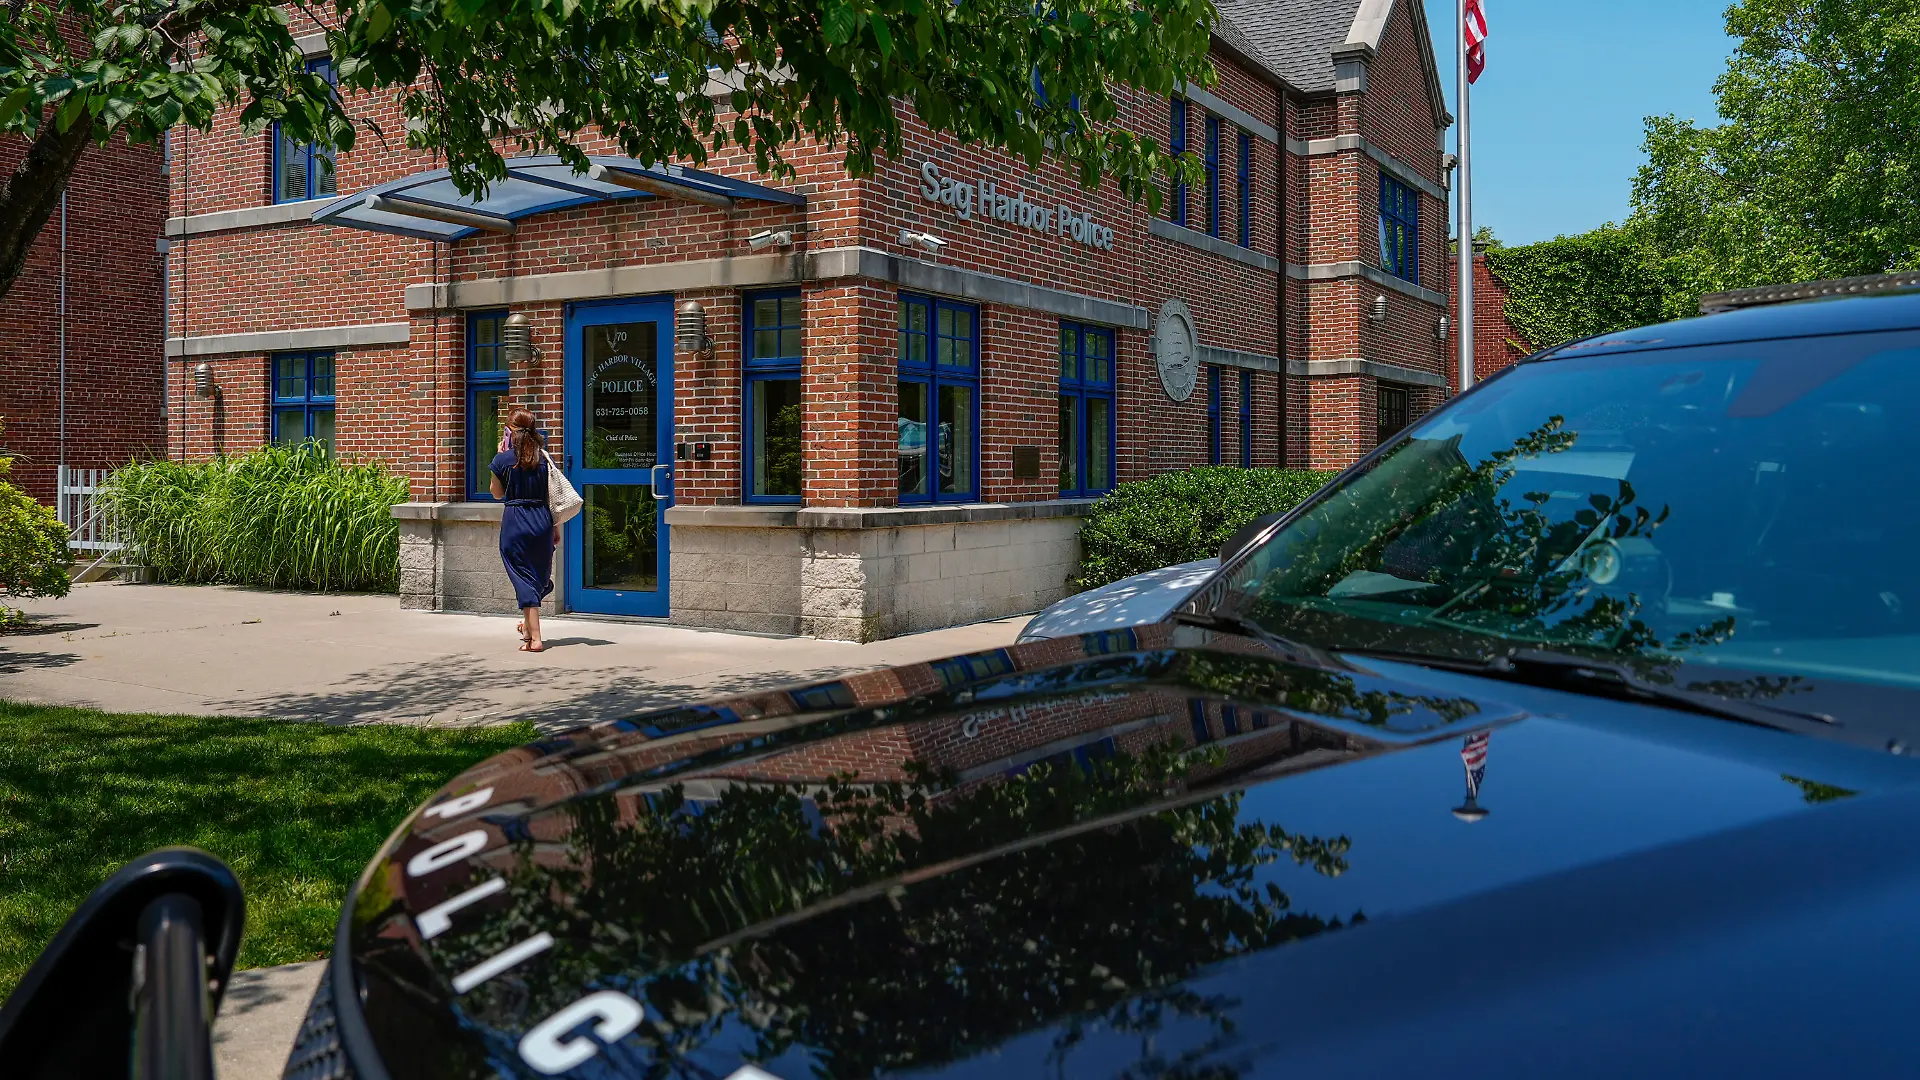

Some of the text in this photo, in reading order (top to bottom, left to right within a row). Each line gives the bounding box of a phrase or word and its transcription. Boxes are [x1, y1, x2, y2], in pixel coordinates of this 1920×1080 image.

[919, 161, 1115, 251] Sag Harbor Police
[616, 331, 627, 342] 70
[587, 354, 658, 389] SAG HARBOR VILLAGE
[600, 380, 644, 394] POLICE
[595, 406, 649, 417] 631-725-0058
[407, 786, 785, 1080] POLIC
